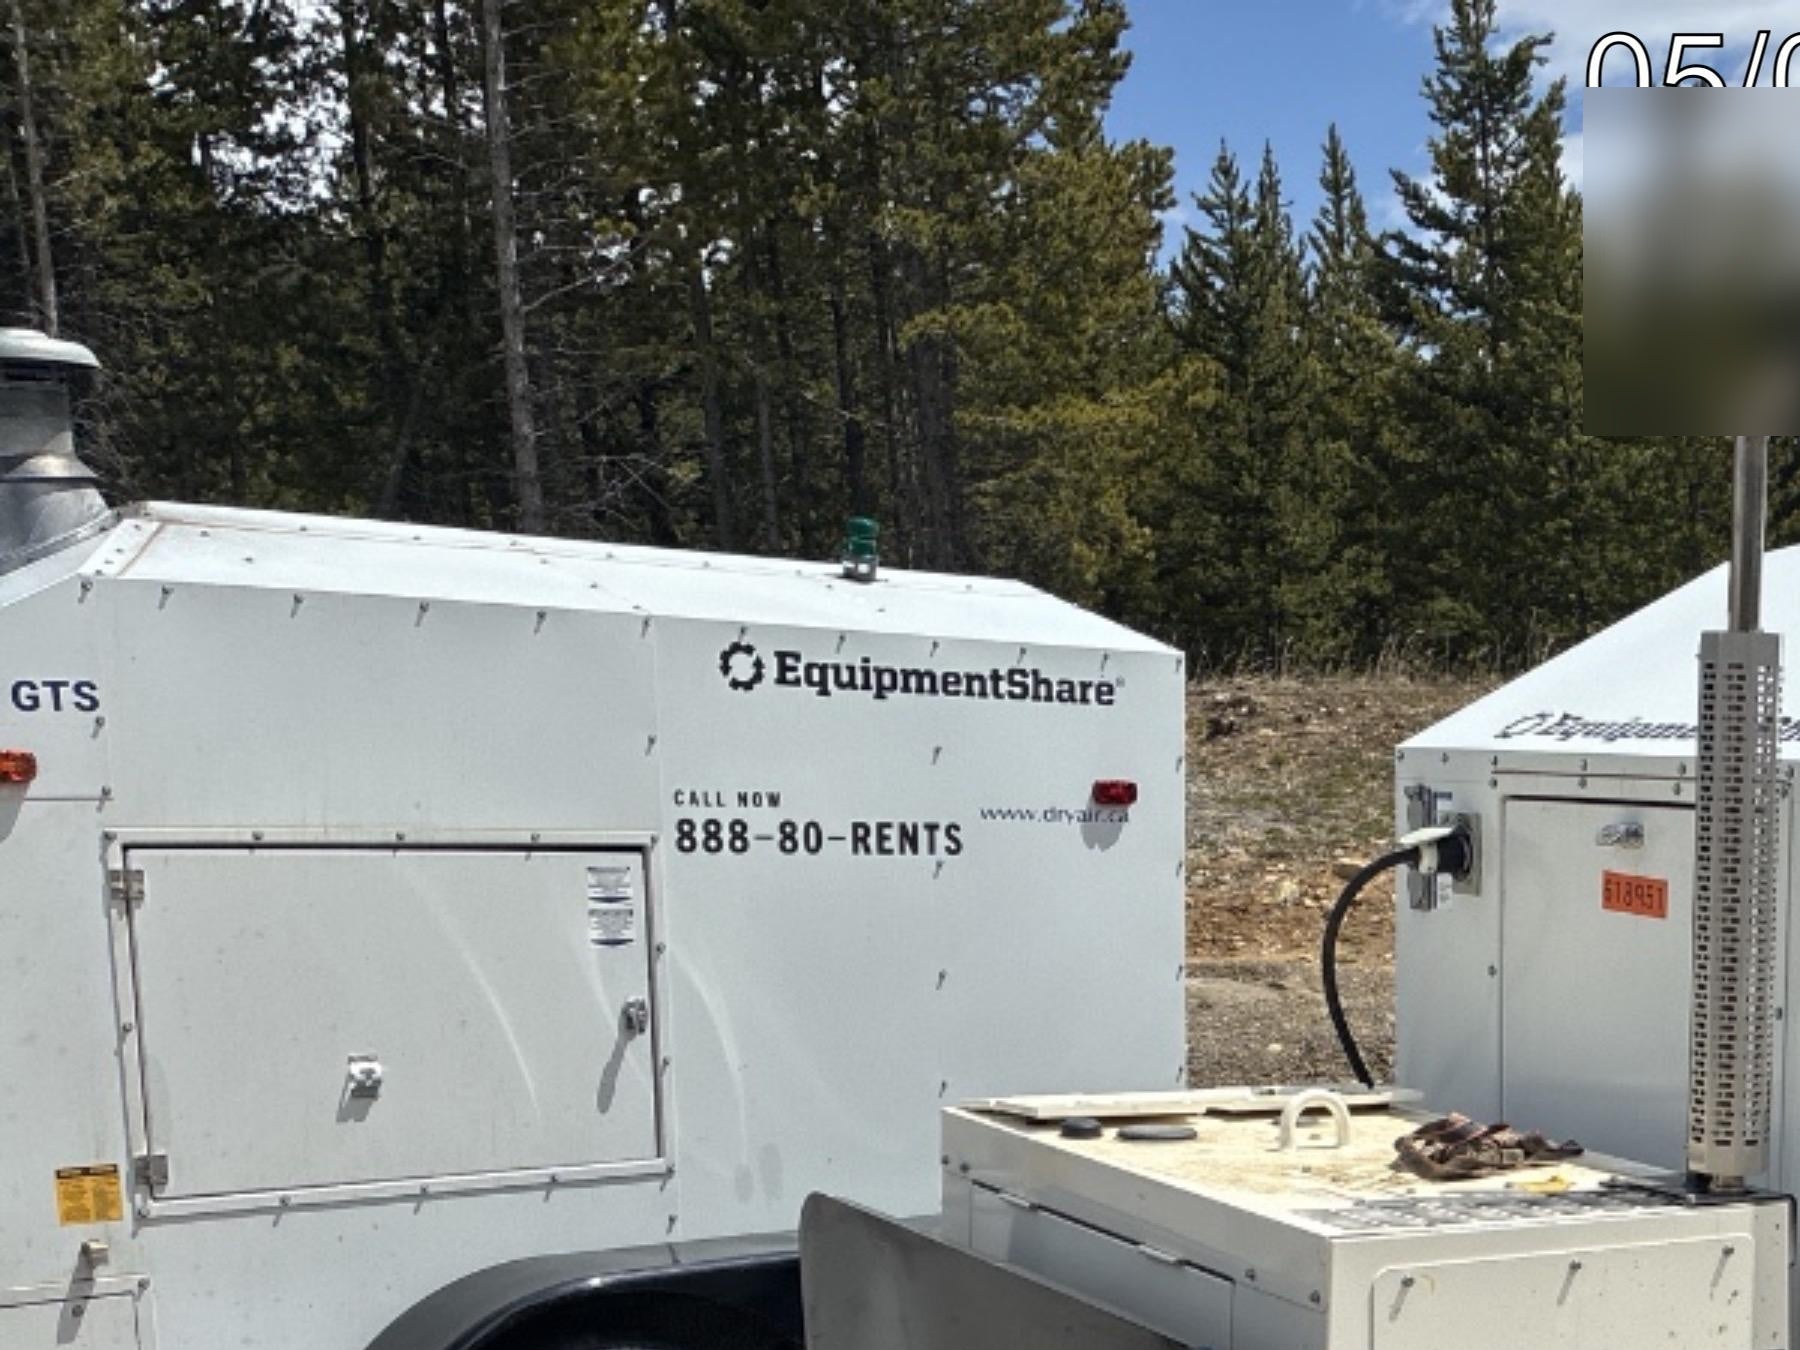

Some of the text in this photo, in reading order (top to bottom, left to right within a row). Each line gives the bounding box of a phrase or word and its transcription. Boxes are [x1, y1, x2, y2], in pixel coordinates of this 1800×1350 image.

[773, 650, 1117, 706] EquipmentShare
[11, 680, 100, 712] GTS
[673, 788, 782, 808] CALL NOW
[675, 818, 964, 856] 888-80-RENTS
